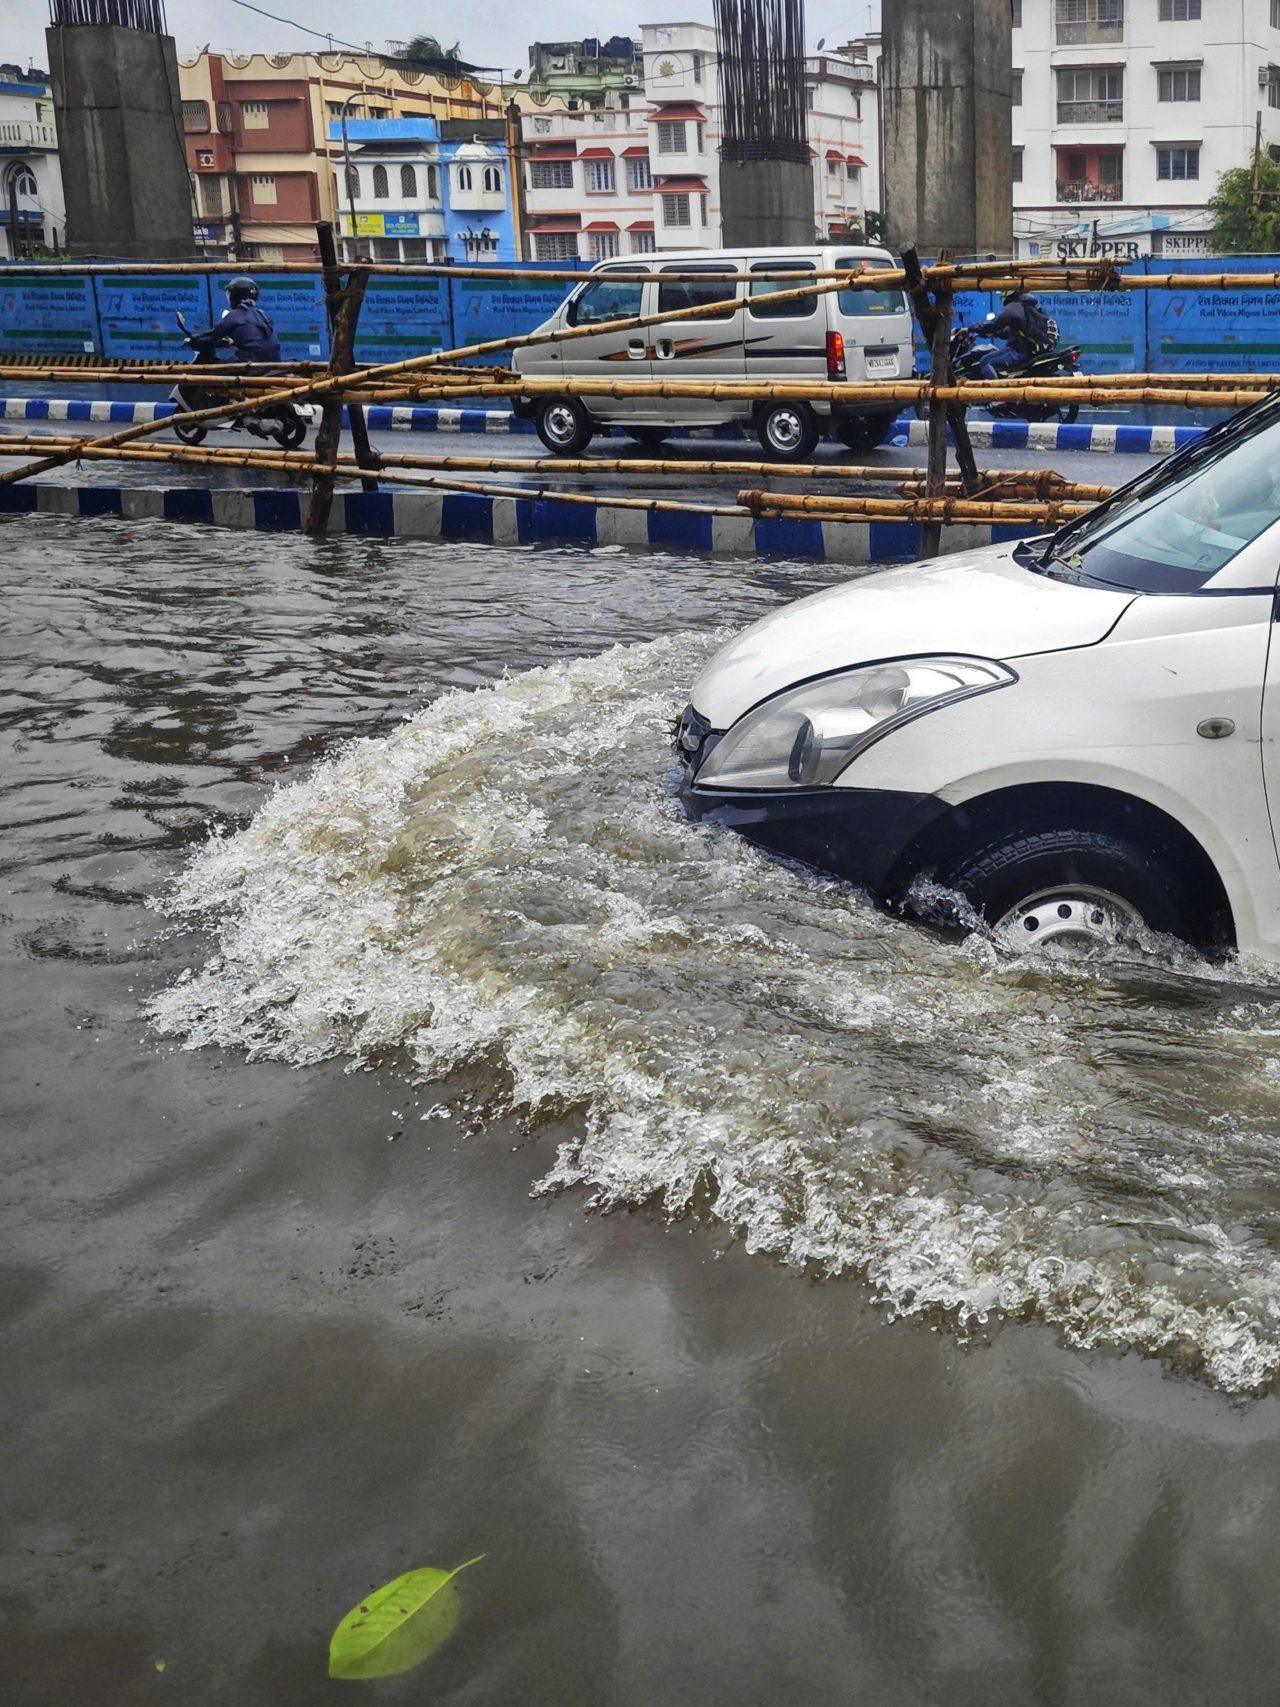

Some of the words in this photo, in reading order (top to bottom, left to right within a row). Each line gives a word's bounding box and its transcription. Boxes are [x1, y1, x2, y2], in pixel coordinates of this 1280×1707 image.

[1057, 242, 1140, 259] SKIPPER
[1200, 309, 1215, 317] Rail
[1216, 309, 1237, 317] Vikas
[1237, 309, 1261, 319] Nigam
